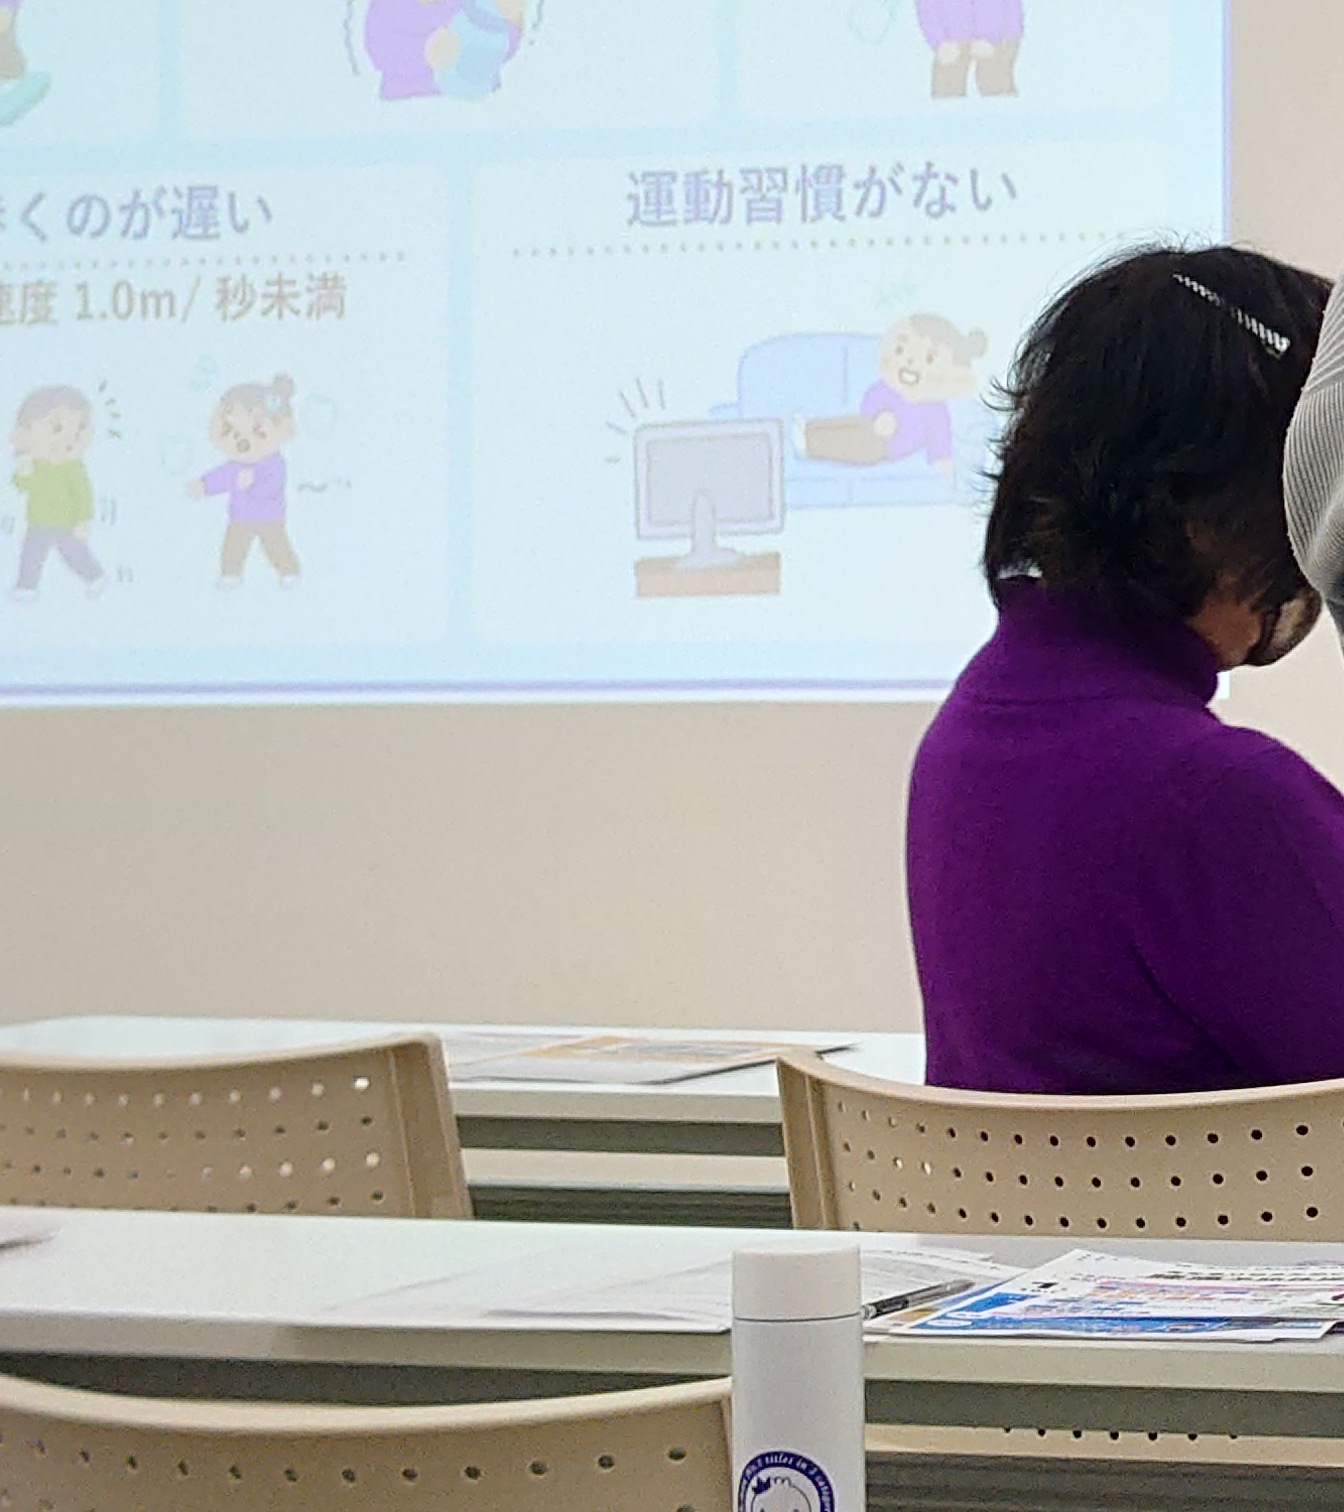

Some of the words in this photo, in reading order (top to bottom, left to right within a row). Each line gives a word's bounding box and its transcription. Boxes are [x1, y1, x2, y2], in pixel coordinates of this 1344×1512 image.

[0, 185, 273, 241] くのが遅い
[626, 161, 1017, 228] 運動習慣がない
